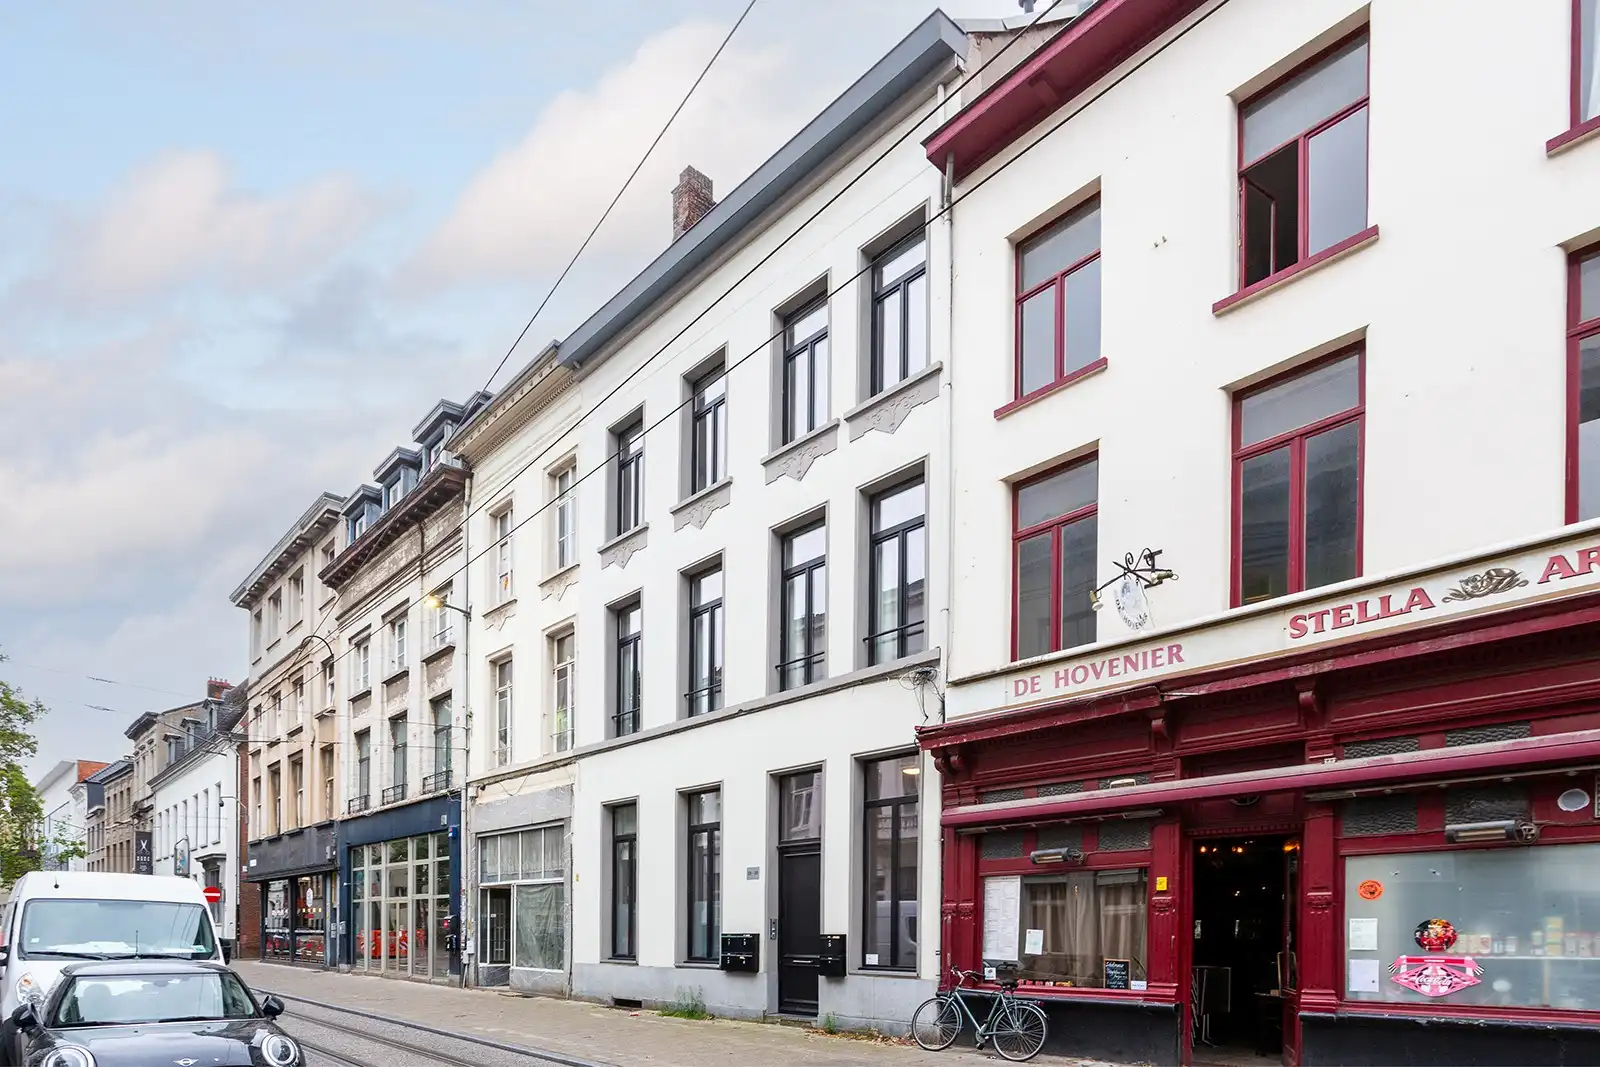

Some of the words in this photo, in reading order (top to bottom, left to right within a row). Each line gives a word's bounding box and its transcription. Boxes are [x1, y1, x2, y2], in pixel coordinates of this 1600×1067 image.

[1288, 587, 1436, 639] STELLA
[1014, 675, 1042, 697] DE
[1054, 643, 1185, 689] HOVENIER
